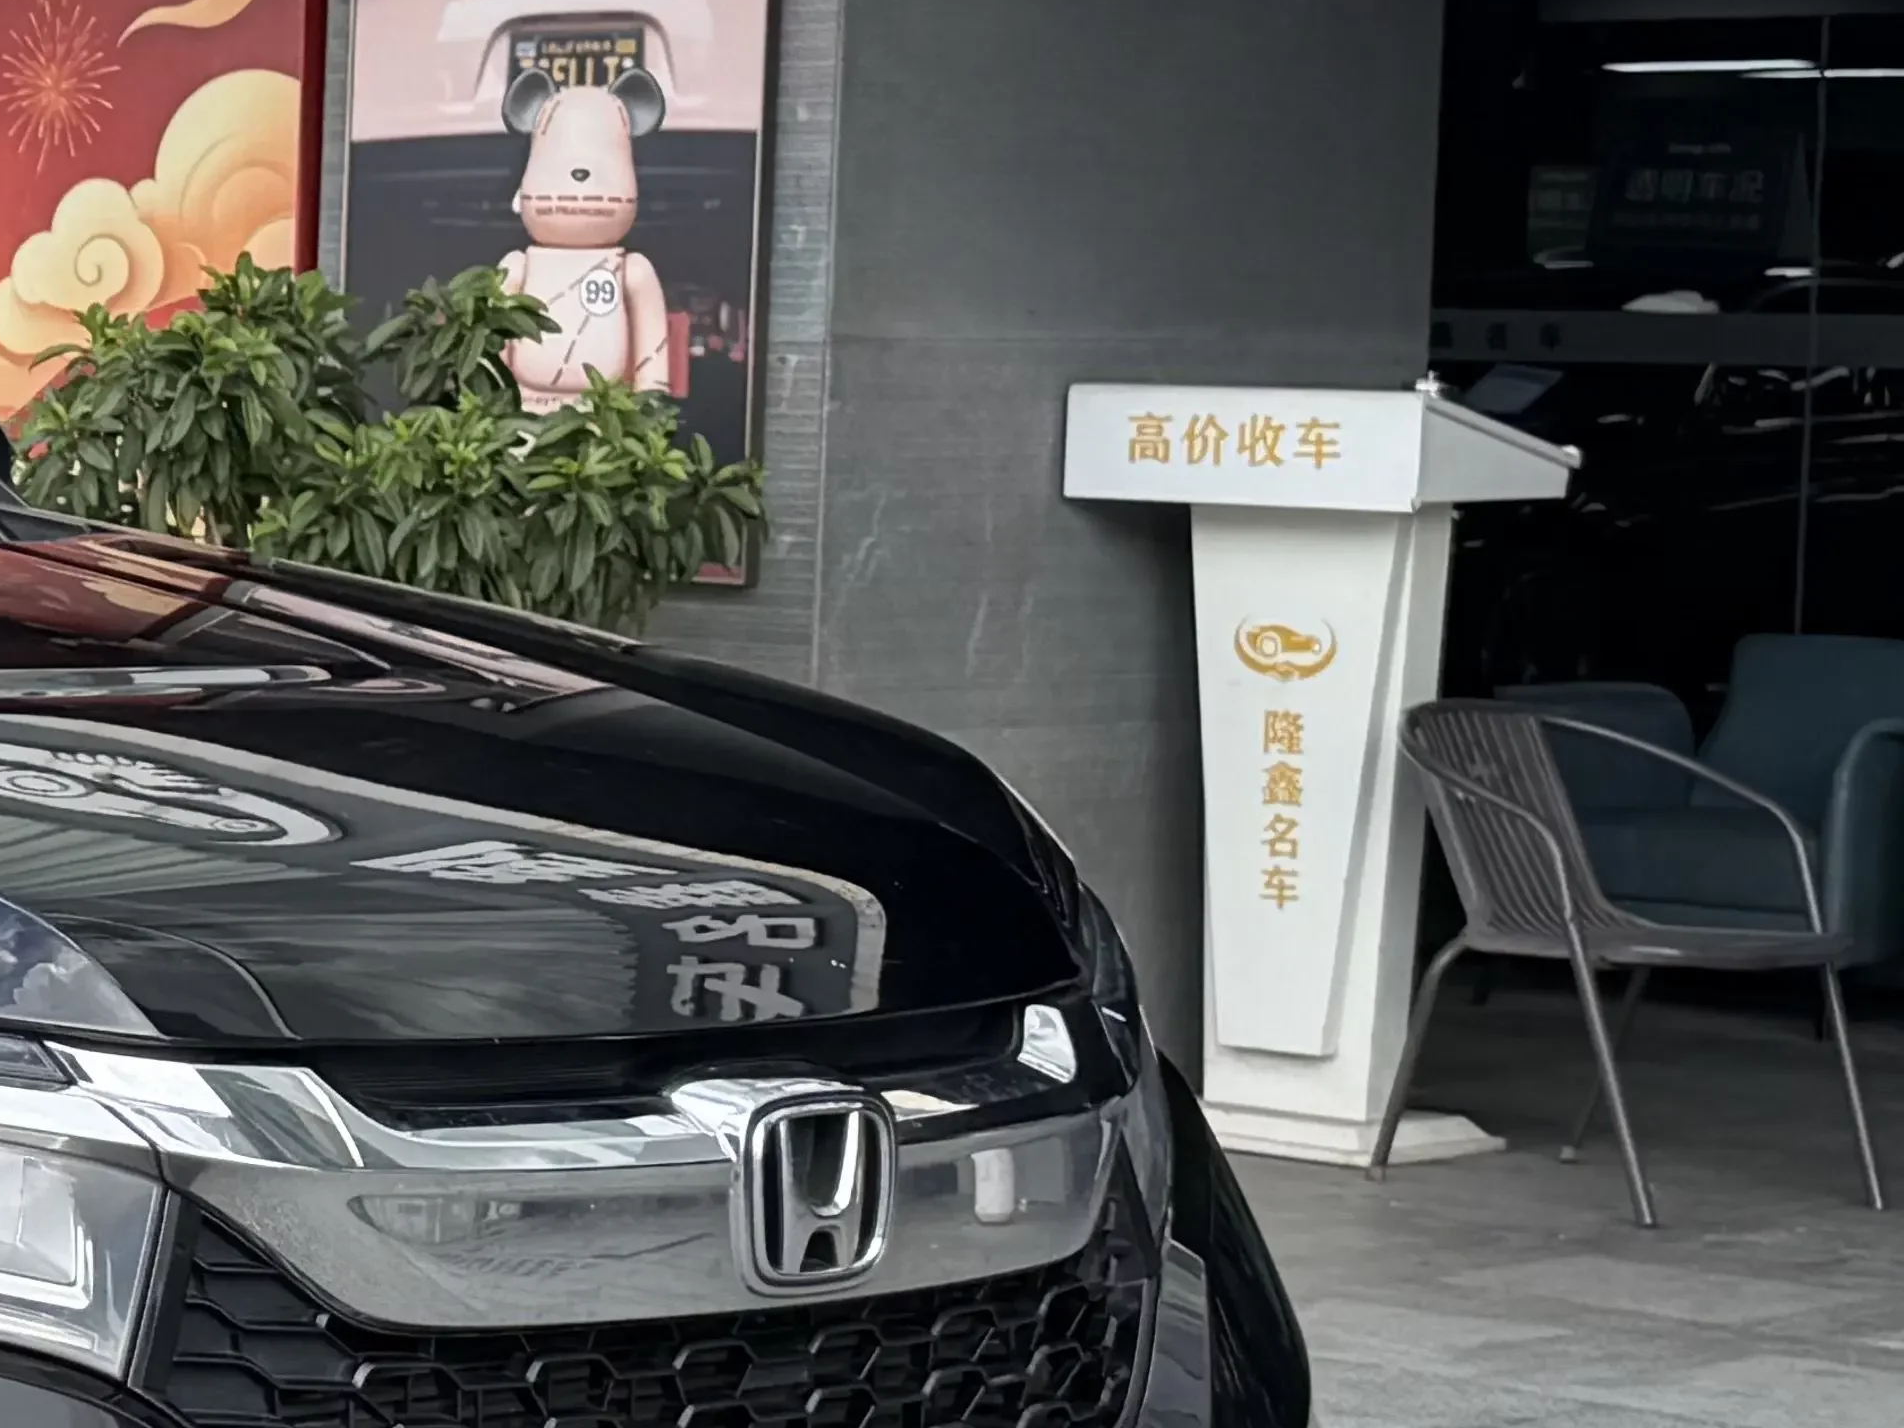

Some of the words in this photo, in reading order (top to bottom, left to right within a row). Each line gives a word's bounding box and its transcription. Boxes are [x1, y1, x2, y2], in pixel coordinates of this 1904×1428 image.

[586, 280, 616, 304] 99
[1127, 413, 1342, 470] 高价收车
[1259, 709, 1304, 911] 隆鑫名车
